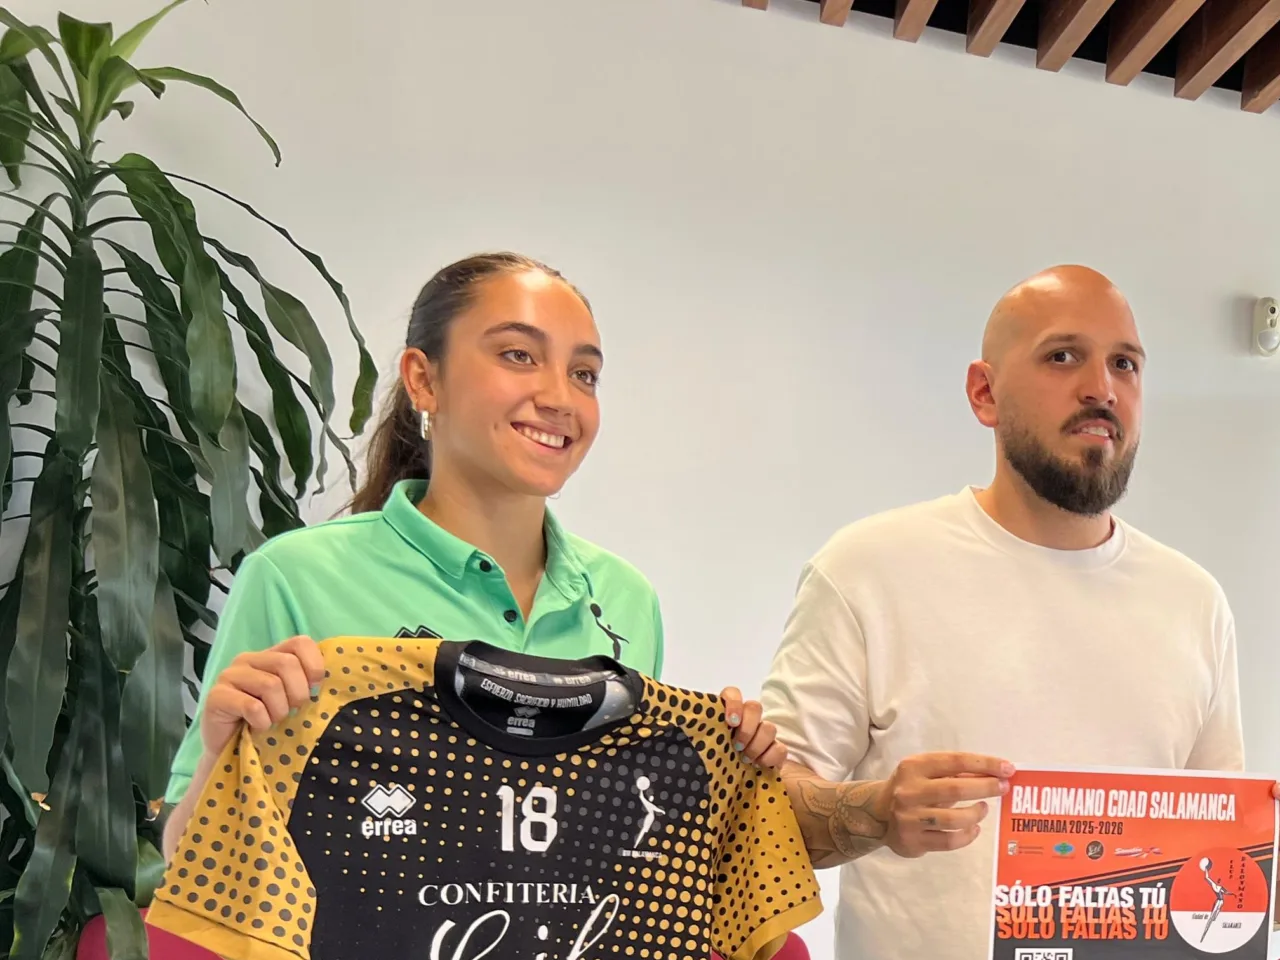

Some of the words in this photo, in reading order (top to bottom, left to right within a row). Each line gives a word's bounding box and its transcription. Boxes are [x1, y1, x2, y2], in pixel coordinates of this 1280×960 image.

[1011, 785, 1106, 817] BALONMANO
[1107, 789, 1148, 819] CDAD
[1149, 791, 1236, 822] SALAMANCA
[496, 785, 559, 852] 18
[1011, 818, 1068, 833] TEMPORADA
[1069, 820, 1124, 835] 2025-2026
[418, 882, 597, 906] CONFITERIA
[994, 880, 1053, 907] SÓLO
[1058, 886, 1134, 908] FALTAS
[1139, 882, 1167, 908] TÚ
